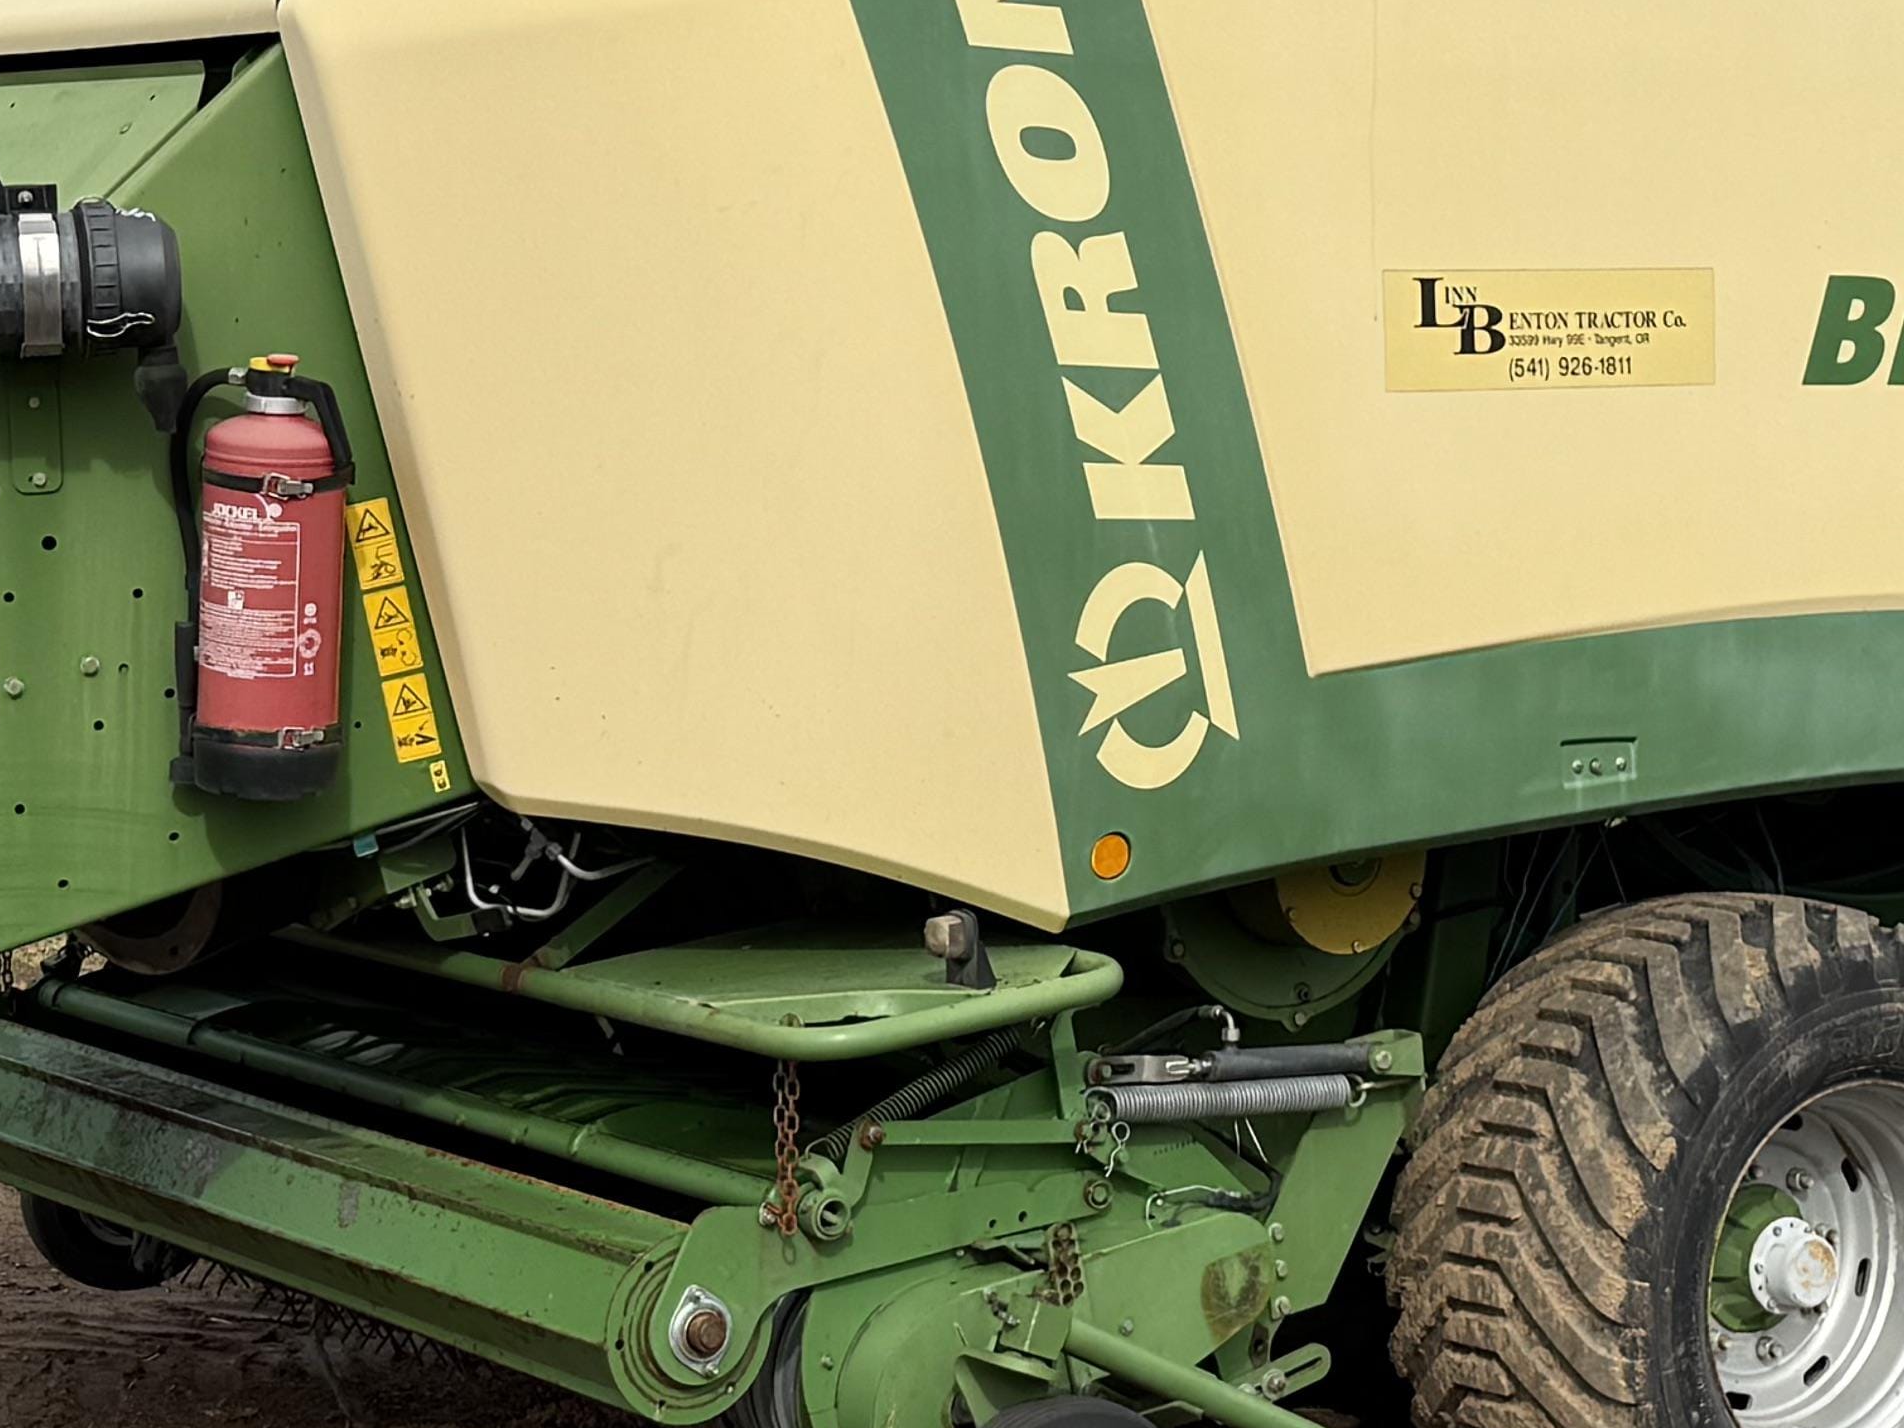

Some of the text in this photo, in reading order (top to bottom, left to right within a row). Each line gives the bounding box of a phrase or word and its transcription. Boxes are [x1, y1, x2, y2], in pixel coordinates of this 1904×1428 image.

[1413, 277, 1477, 328] LINN
[1574, 311, 1657, 330] TRACTOR
[1508, 355, 1633, 382] (541) 926-1811
